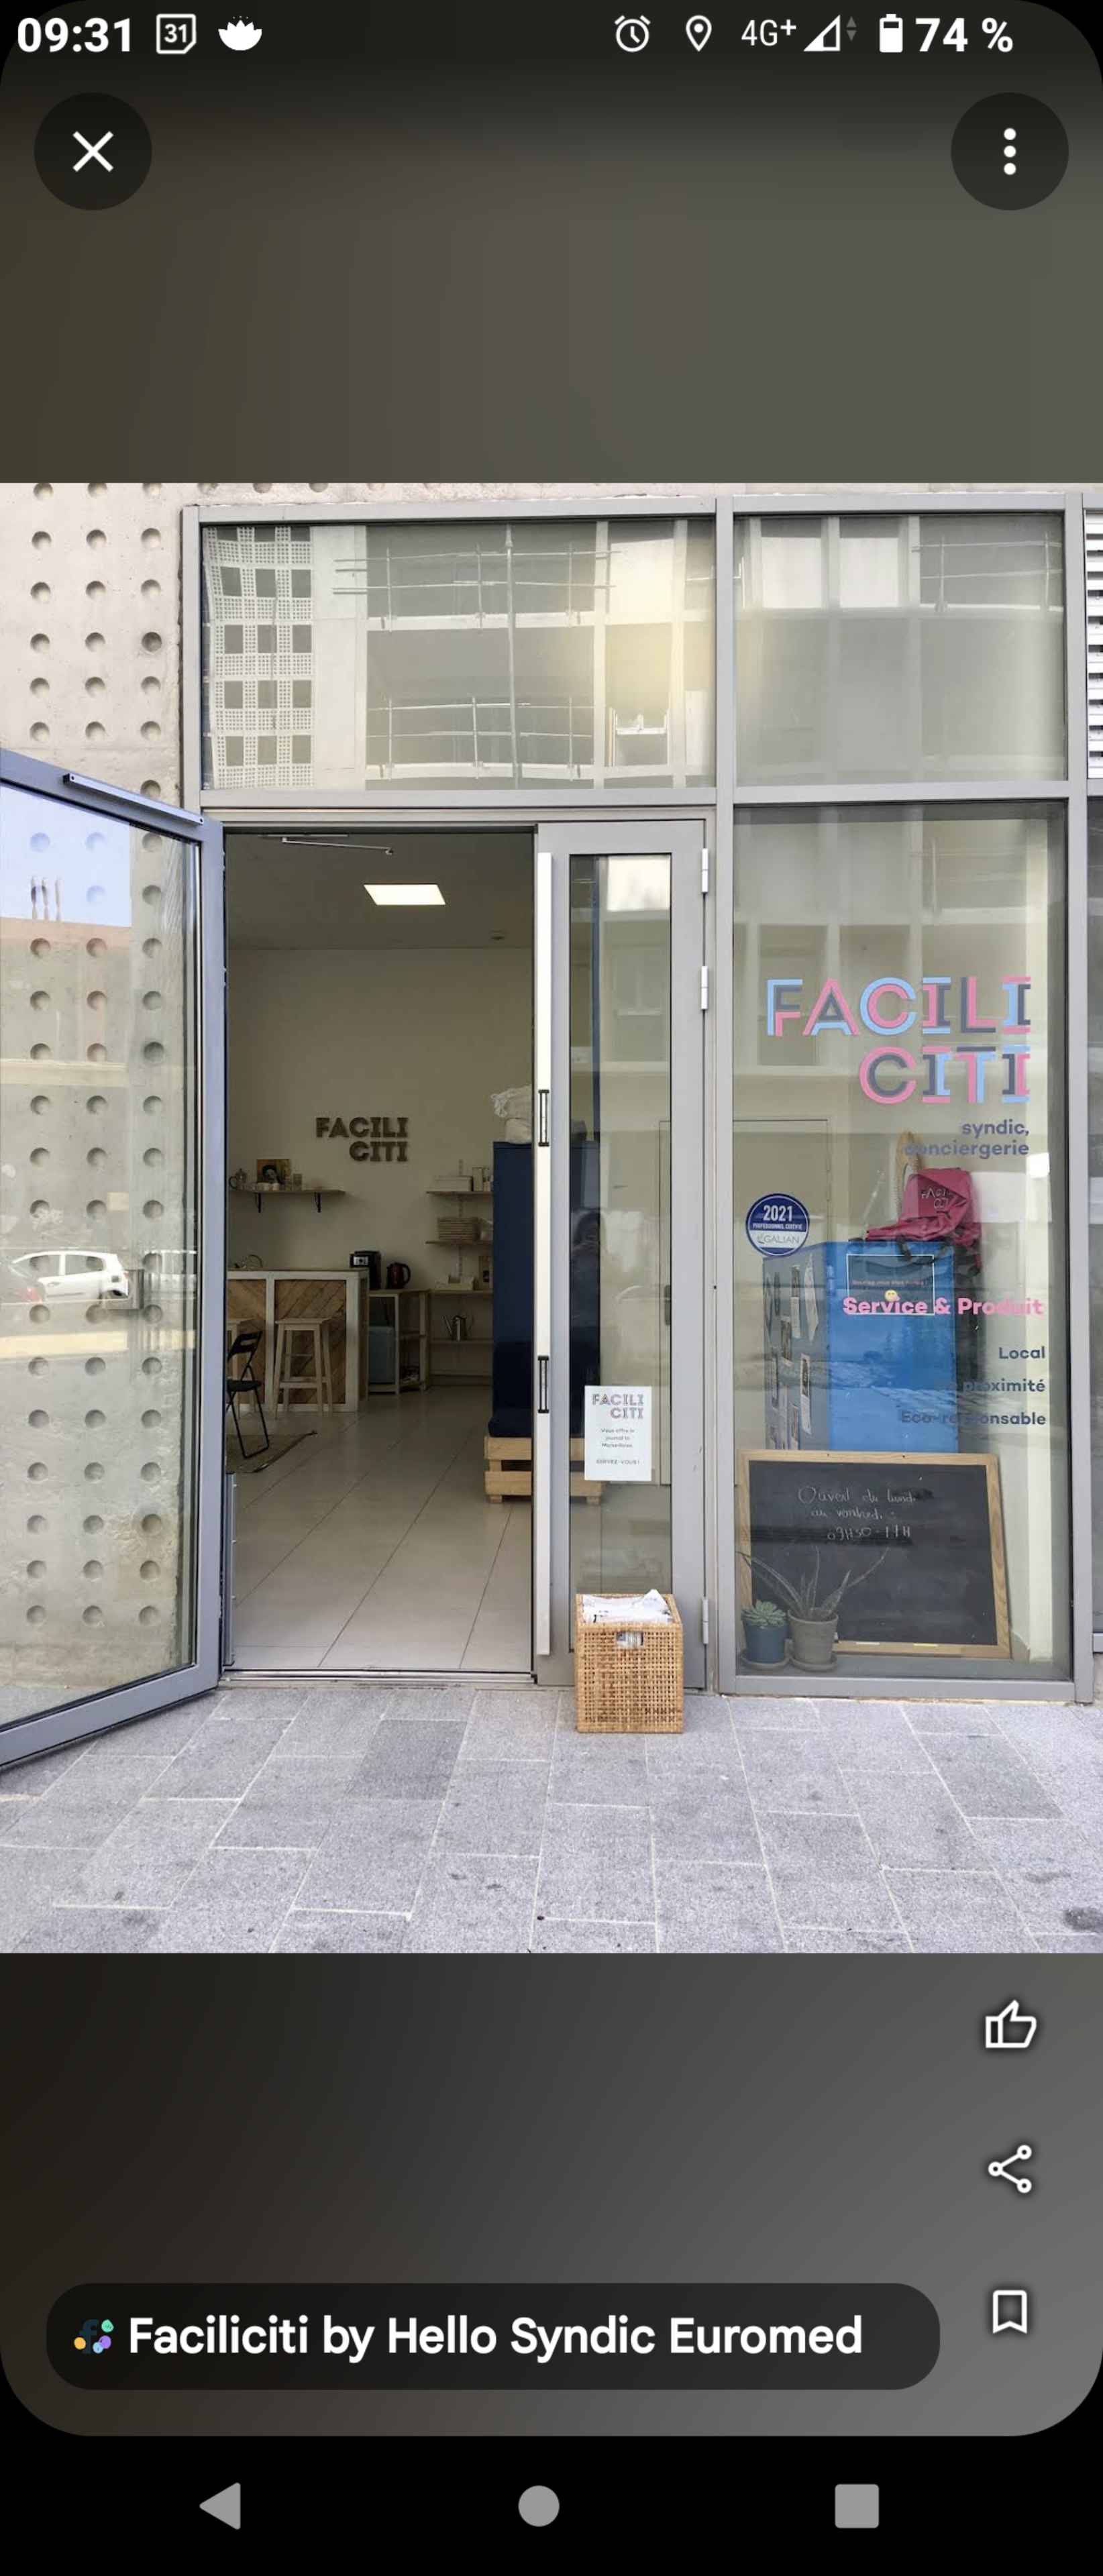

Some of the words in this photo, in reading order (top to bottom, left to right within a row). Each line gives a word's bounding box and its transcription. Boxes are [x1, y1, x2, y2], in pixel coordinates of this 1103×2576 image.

[767, 975, 1031, 1036] FACILI
[859, 1046, 1031, 1104] CITI
[315, 1116, 409, 1138] FACILI
[961, 1118, 1029, 1139] syndic,
[349, 1140, 408, 1162] CITI
[904, 1140, 1029, 1160] conciergerie
[763, 1205, 793, 1222] 2021
[764, 1235, 800, 1244] GALIAN
[843, 1296, 929, 1315] Service
[935, 1297, 951, 1315] &
[957, 1295, 1043, 1316] Produit
[998, 1346, 1045, 1359] Local
[962, 1378, 1046, 1395] proximité
[592, 1393, 644, 1405] FACILI
[611, 1407, 644, 1419] CITI
[901, 1411, 1046, 1427] Eco-reonsable
